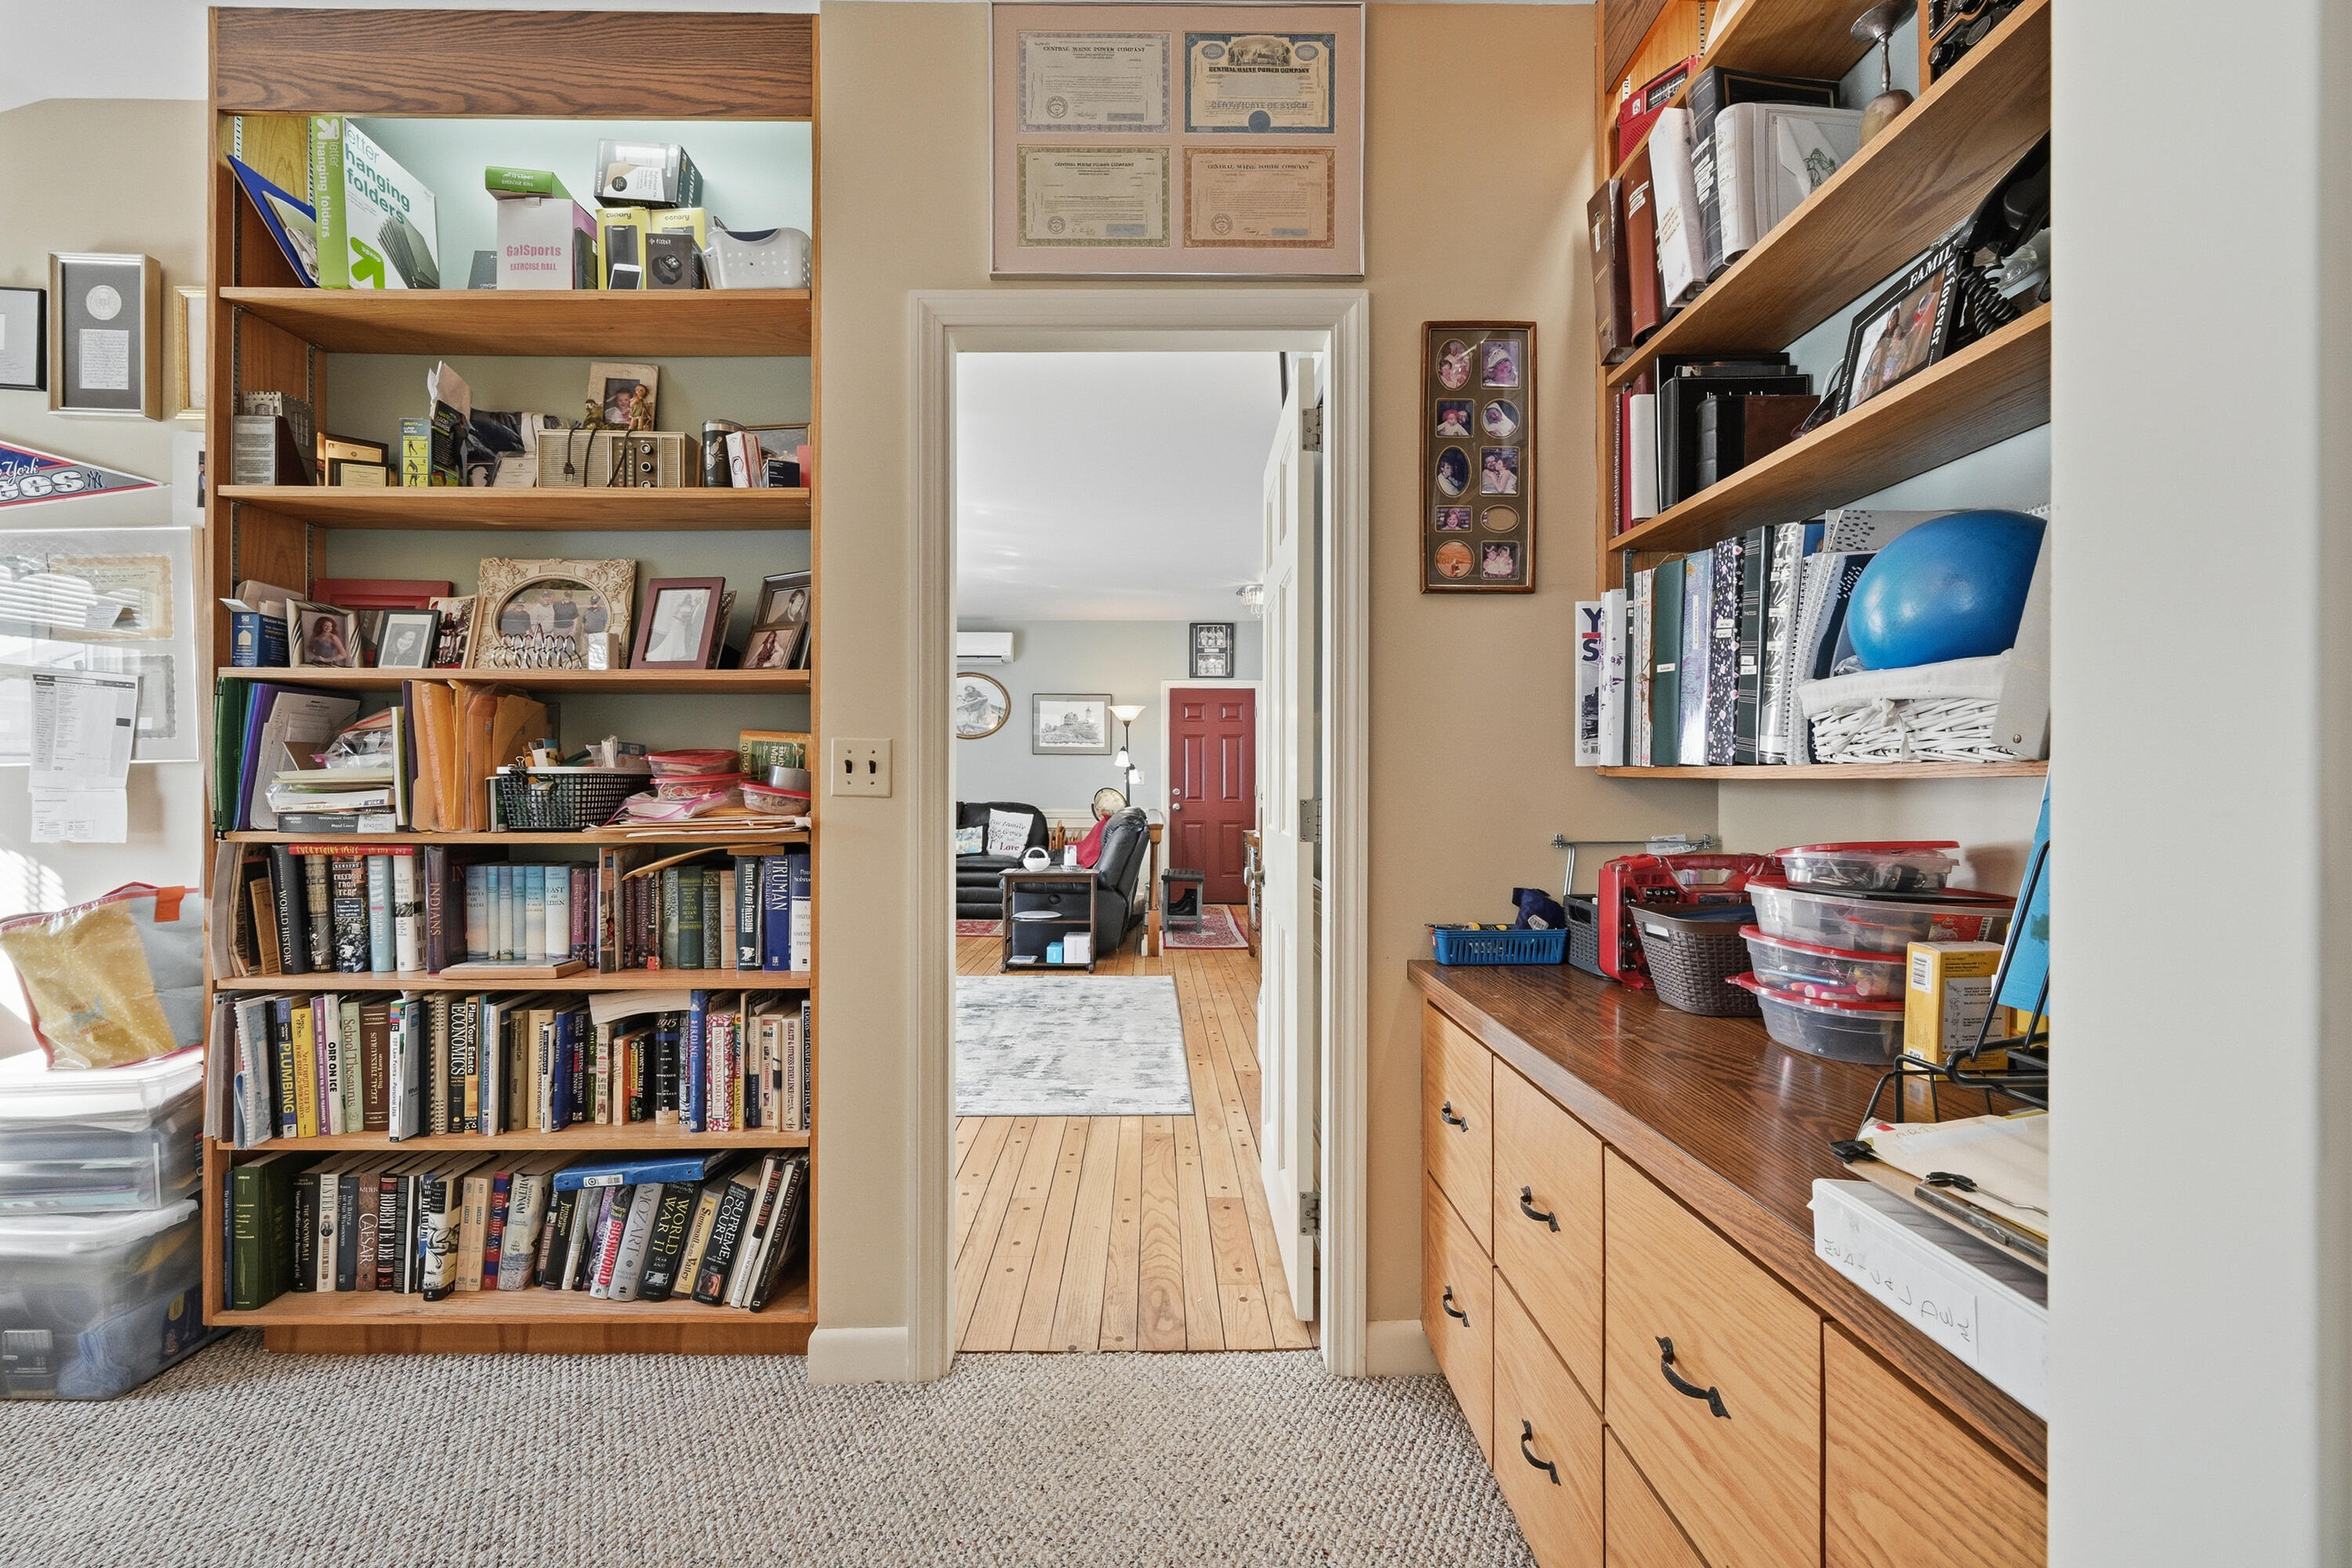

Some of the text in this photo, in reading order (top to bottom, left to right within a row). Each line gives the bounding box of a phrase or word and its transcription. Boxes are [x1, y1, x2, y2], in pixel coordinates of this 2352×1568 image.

[315, 142, 327, 192] hanging
[345, 143, 411, 213] hanging
[319, 196, 330, 238] folders
[347, 167, 406, 225] folders
[506, 245, 562, 257] GalSports
[1930, 276, 1955, 347] forever
[2, 457, 39, 485] York
[1000, 841, 1019, 851] Love
[279, 890, 289, 925] WORLD
[430, 882, 441, 935] INDIANS
[771, 858, 788, 910] TRUMAN
[281, 927, 292, 966] HISTORY
[450, 1005, 466, 1076] ECONOMICS
[467, 1025, 476, 1044] Your
[656, 1018, 678, 1028] 1915
[279, 1043, 295, 1114] PLUMBING
[328, 1041, 337, 1092] ORR ON ICE
[343, 1019, 358, 1108] School Thesaurus
[321, 1178, 335, 1211] CUSTER
[494, 1193, 504, 1213] TOM
[516, 1178, 529, 1214] VIETNAM
[358, 1213, 379, 1265] CAESAR
[378, 1193, 397, 1261] ROBERT E. LEE
[626, 1185, 655, 1255] MOZART
[652, 1196, 677, 1253] WAR II
[665, 1199, 690, 1255] WORLD
[691, 1206, 712, 1247] Stonewall
[713, 1196, 734, 1244] COURT
[597, 1220, 623, 1286] BUSHWORLD
[681, 1256, 698, 1281] Valley
